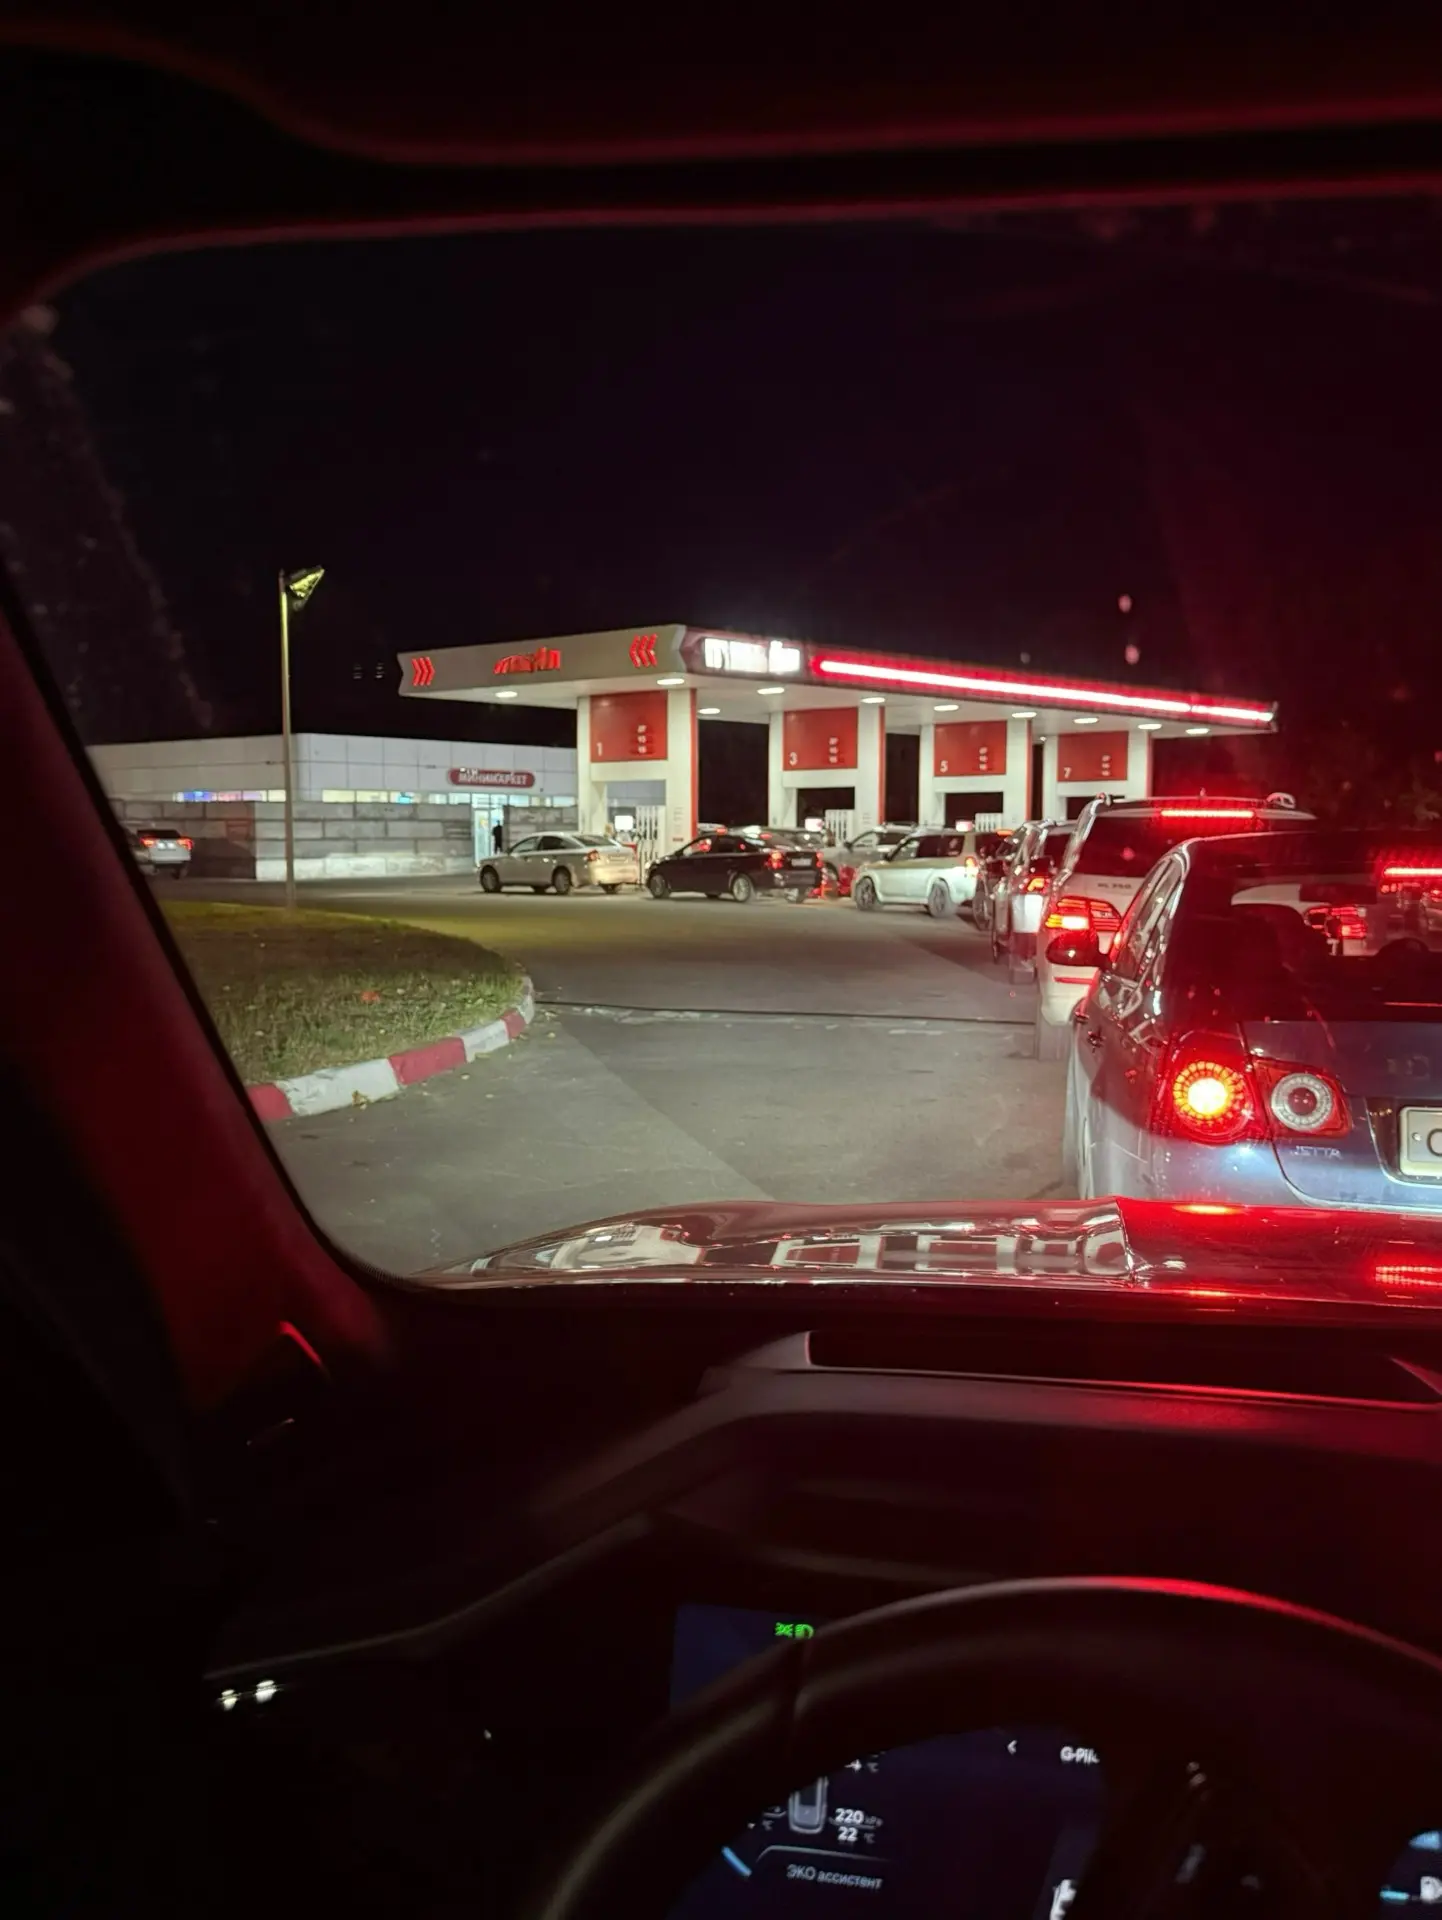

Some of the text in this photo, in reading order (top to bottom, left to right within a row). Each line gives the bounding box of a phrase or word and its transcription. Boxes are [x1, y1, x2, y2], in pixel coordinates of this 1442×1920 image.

[596, 742, 602, 756] 1
[789, 751, 798, 766] 3
[940, 759, 949, 773] 5
[1063, 766, 1072, 779] 7
[1294, 1145, 1343, 1159] JETTA
[835, 1807, 864, 1825] 220
[838, 1826, 858, 1842] 22
[786, 1863, 883, 1890] ЭКО ассистент
